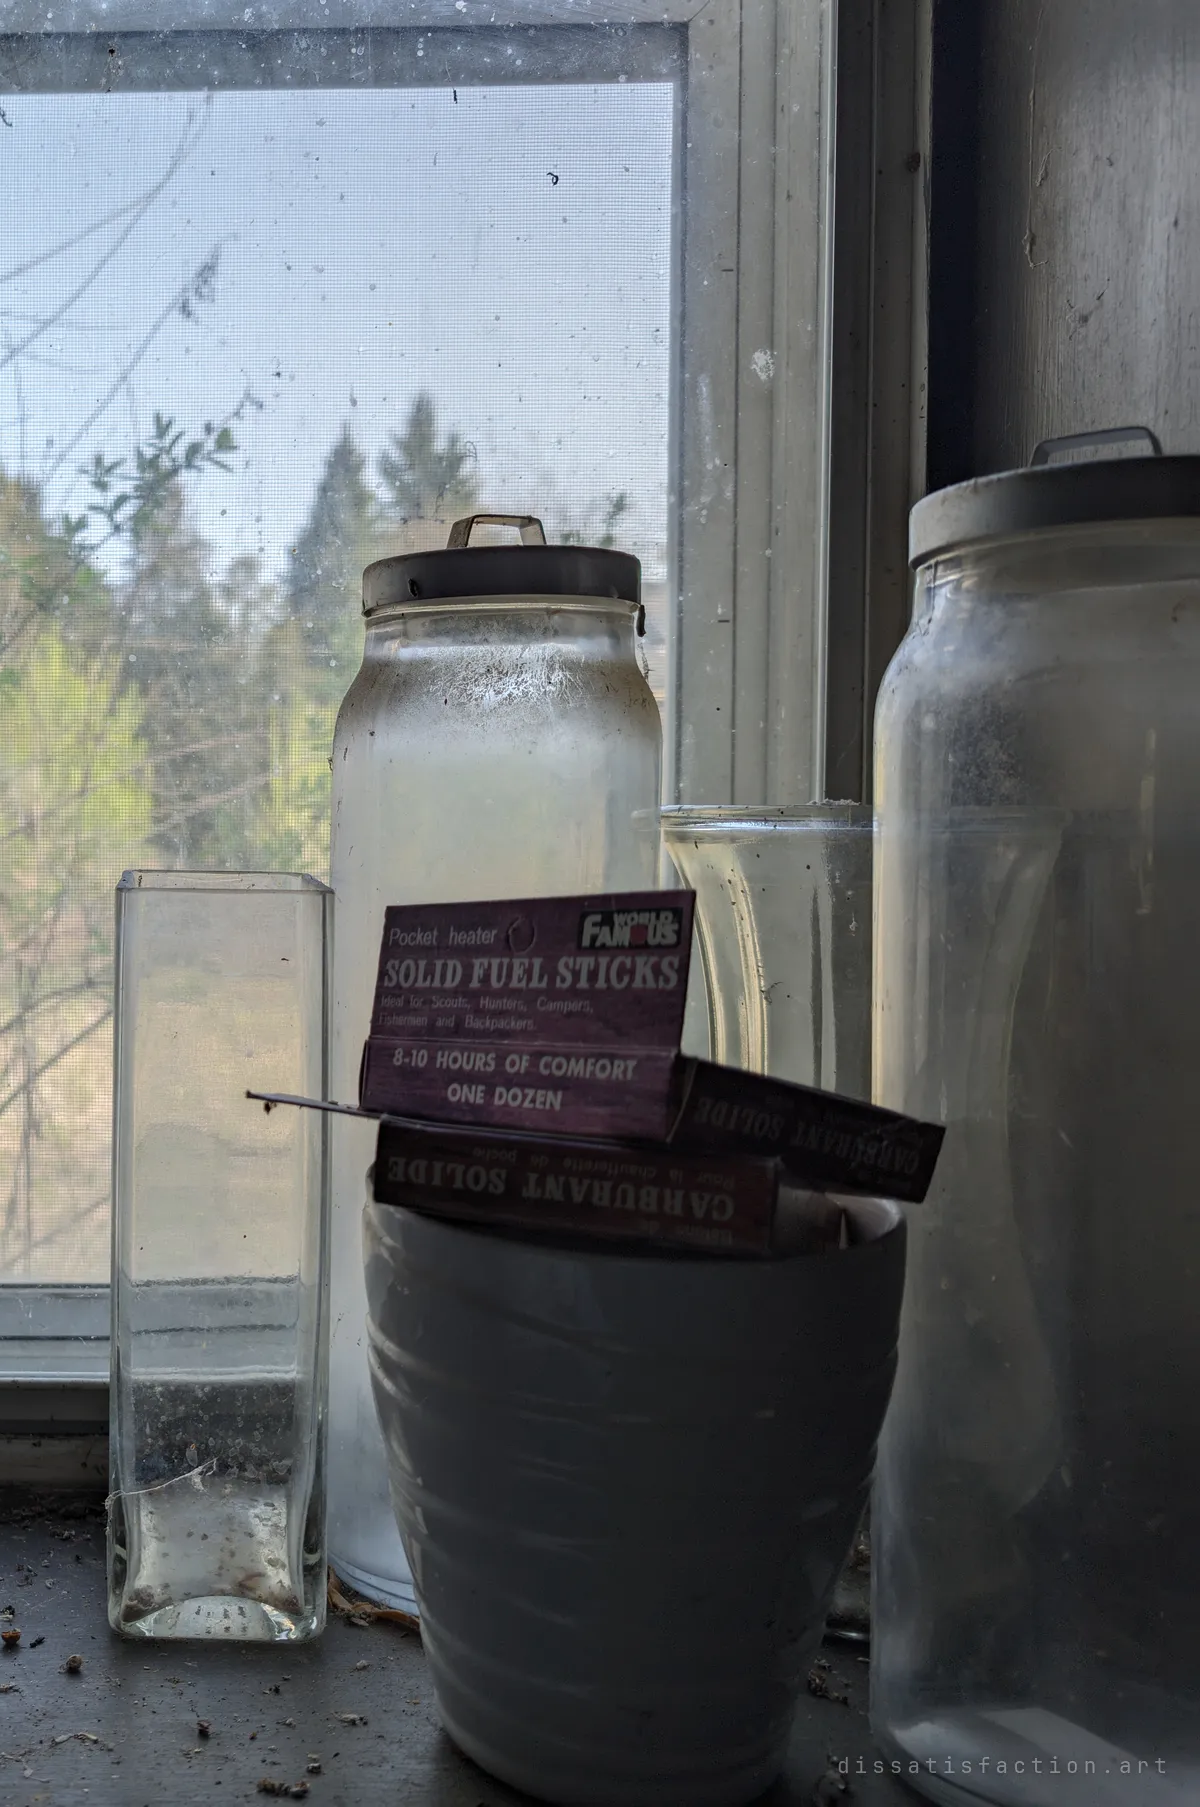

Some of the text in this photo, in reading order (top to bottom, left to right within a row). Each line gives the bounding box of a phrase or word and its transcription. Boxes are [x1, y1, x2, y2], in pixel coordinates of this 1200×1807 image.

[388, 926, 497, 949] Pocket heater
[383, 953, 680, 991] SOLID FUEL STICKS
[379, 995, 404, 1008] Ideal
[409, 995, 425, 1008] for
[378, 1013, 428, 1027] Fishermen
[435, 1014, 455, 1028] and
[392, 1048, 636, 1081] 8-10 HOURS OF COMFORT
[447, 1083, 563, 1111] ONE DOZEN
[694, 1097, 785, 1140] SOLIDE
[788, 1121, 921, 1175] CARBURANT
[387, 1156, 735, 1221] CARBURANT SOLIDE
[696, 1170, 735, 1190] Pour
